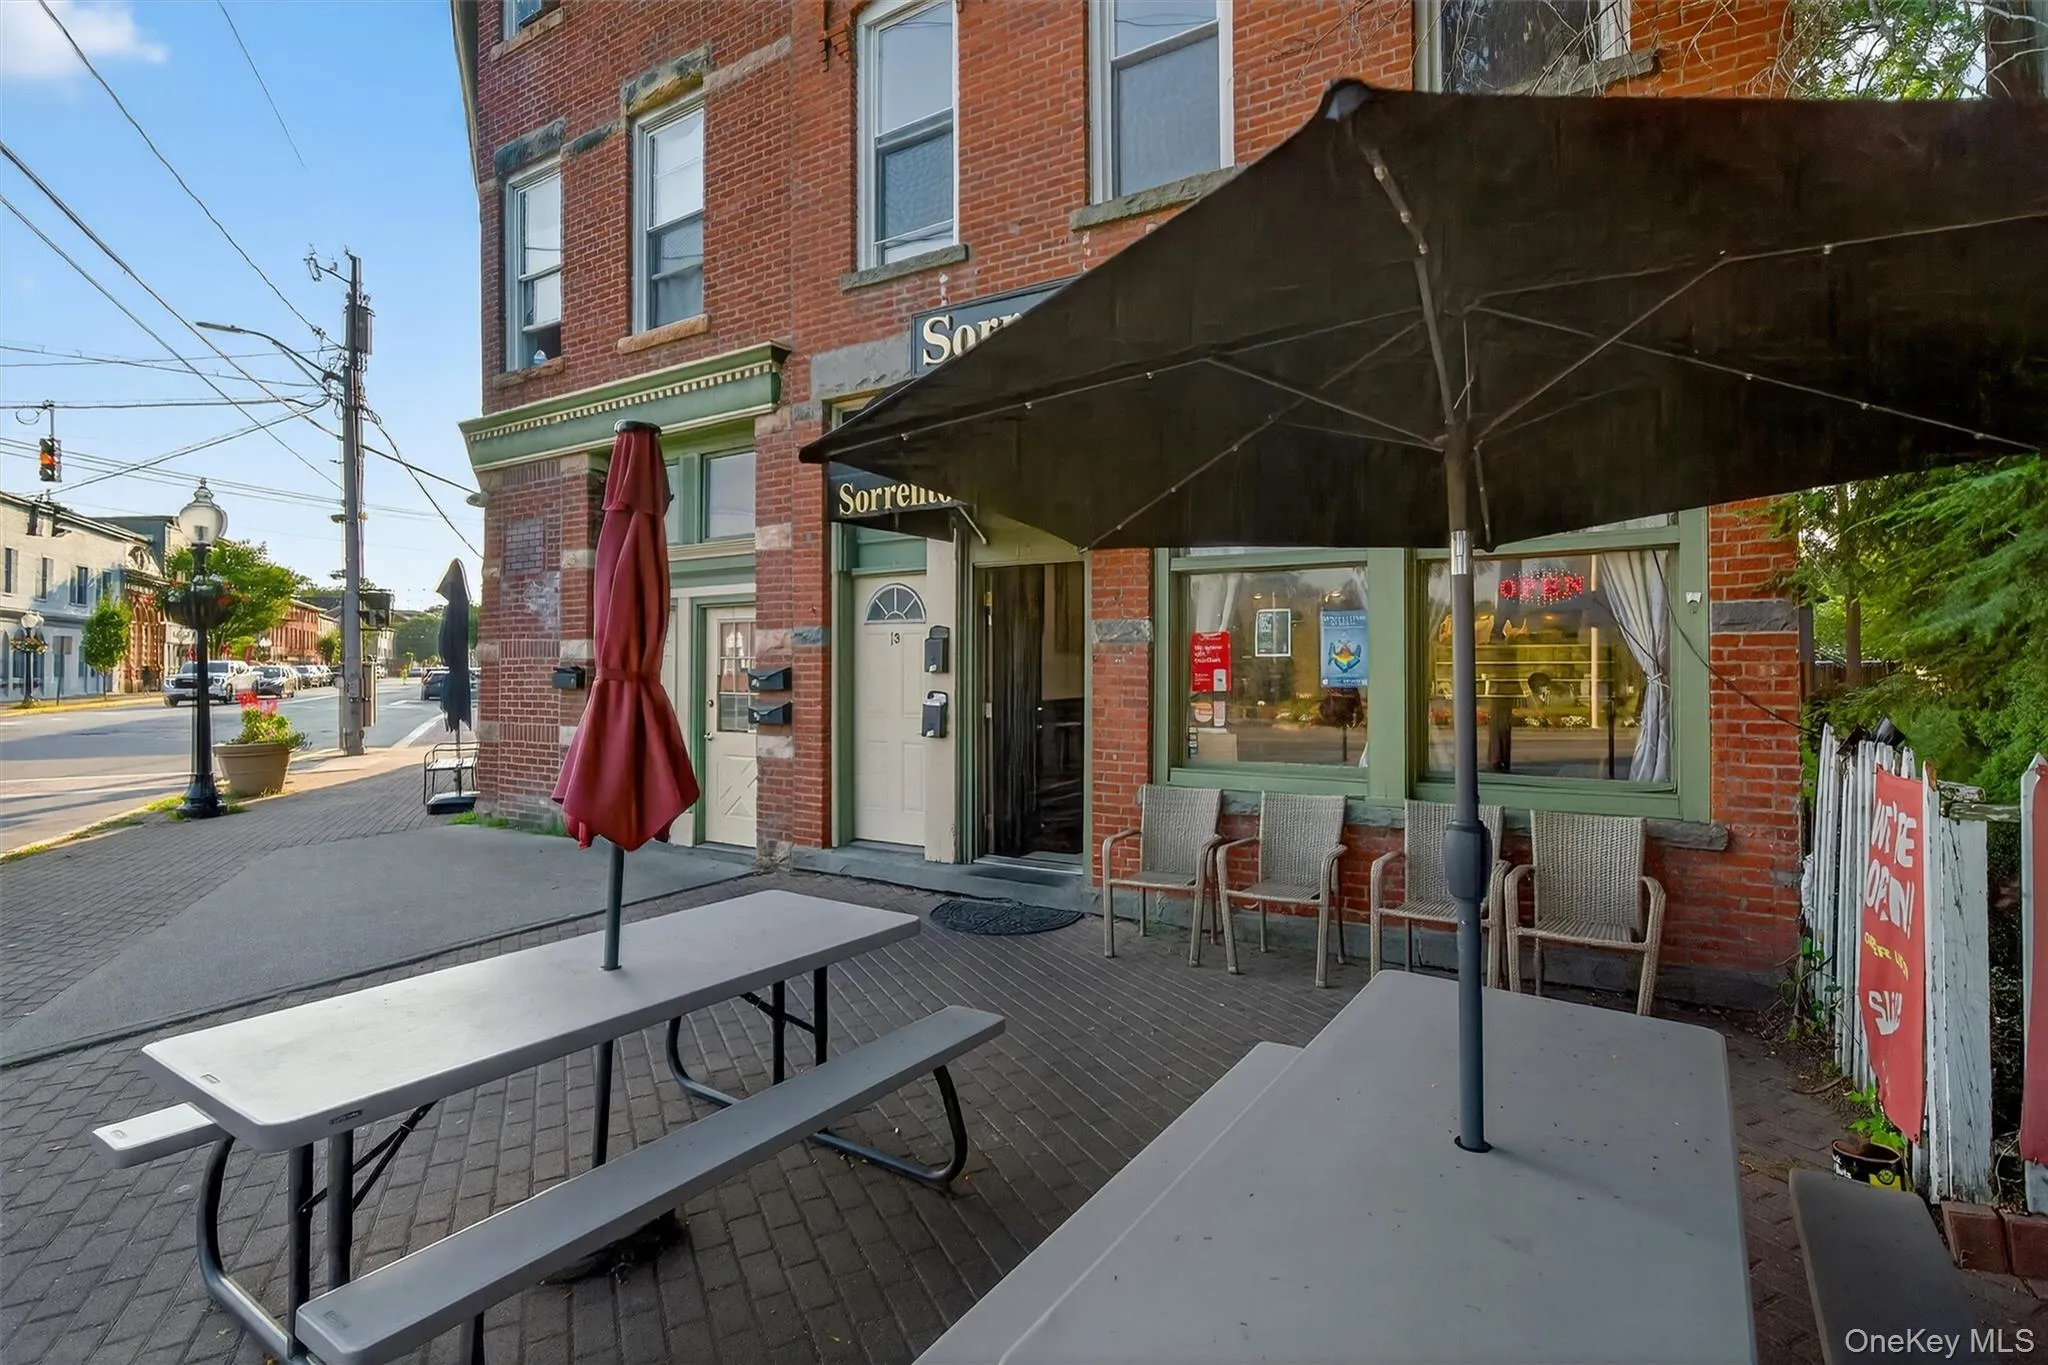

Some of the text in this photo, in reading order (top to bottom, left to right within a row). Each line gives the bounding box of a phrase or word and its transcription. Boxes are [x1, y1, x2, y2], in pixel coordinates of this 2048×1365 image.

[1499, 574, 1585, 601] OPEN
[890, 631, 901, 647] 13
[1865, 858, 1915, 940] OPN!
